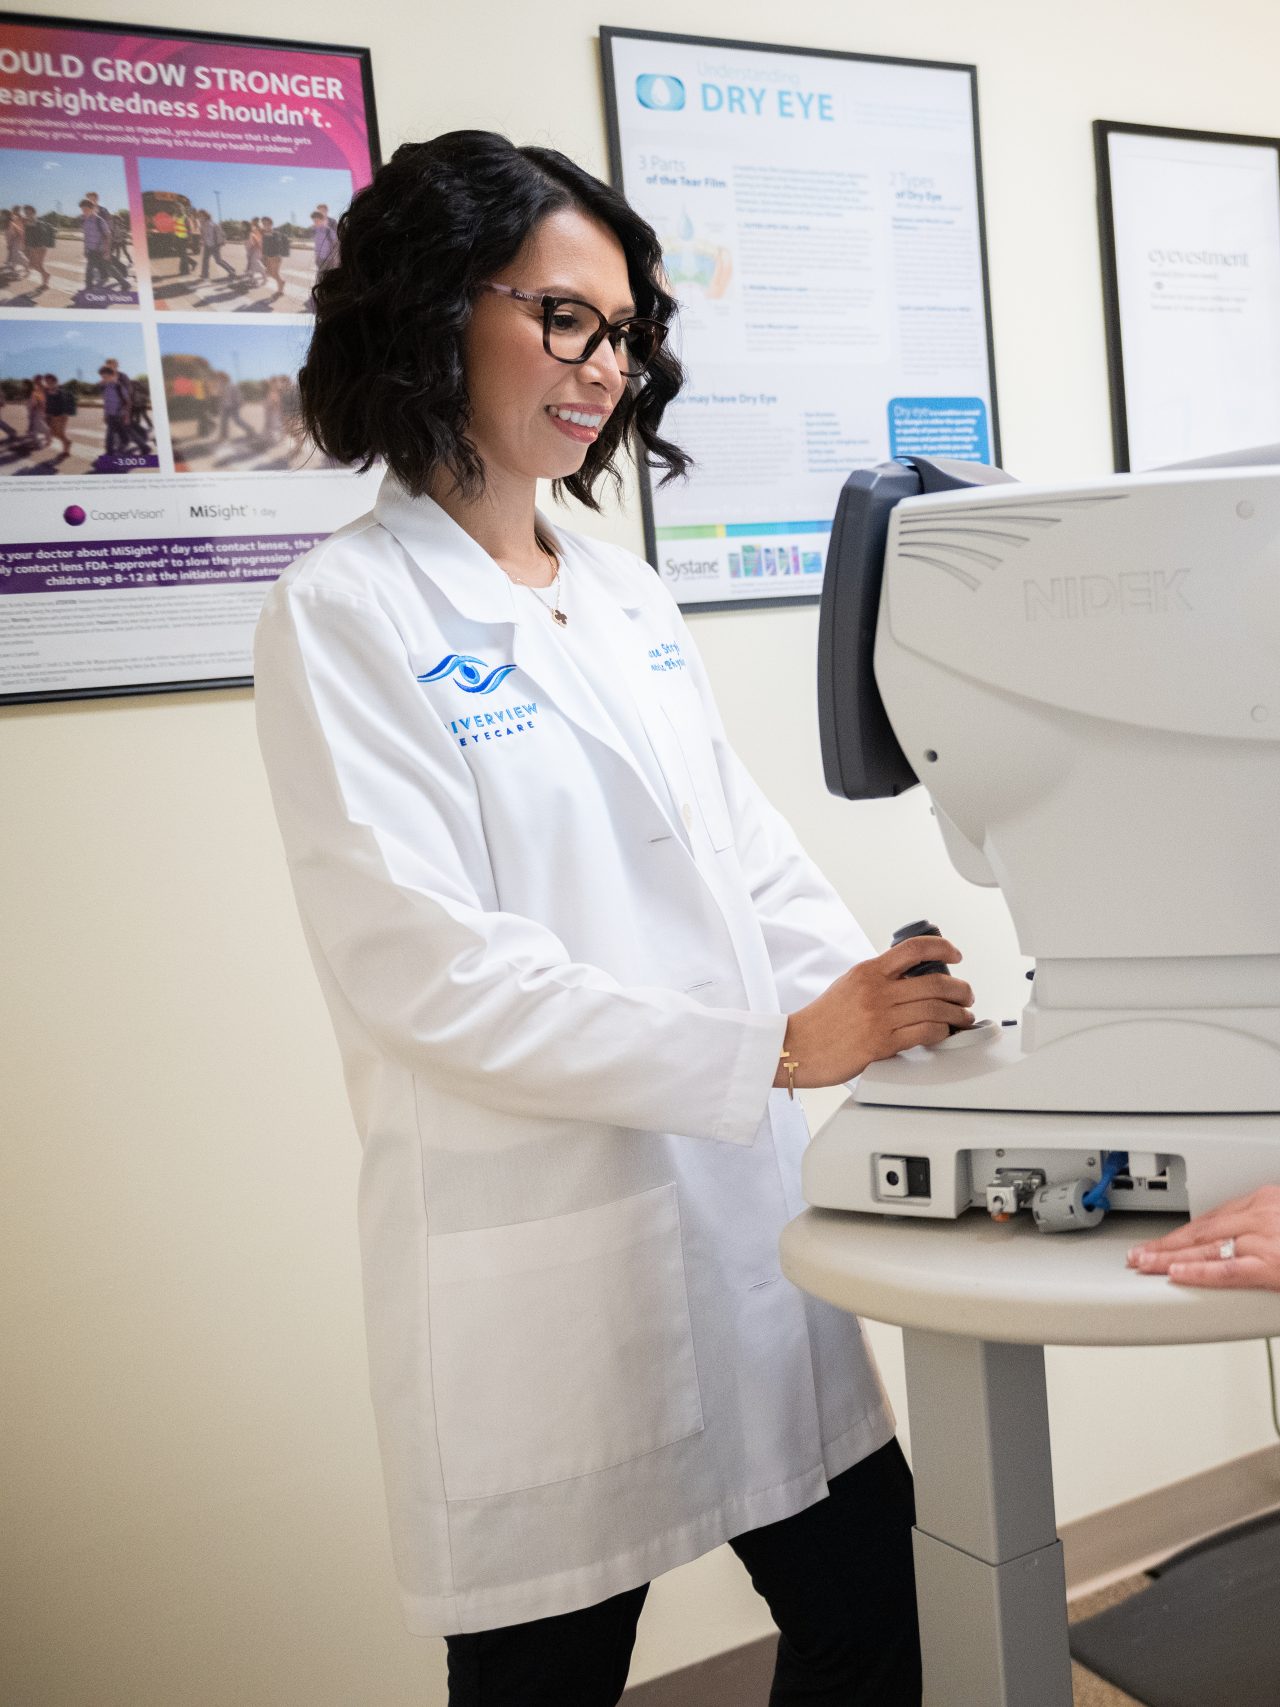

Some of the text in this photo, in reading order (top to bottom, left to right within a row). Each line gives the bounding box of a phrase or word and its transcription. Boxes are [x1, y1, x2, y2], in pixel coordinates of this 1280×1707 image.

[92, 57, 187, 87] GROW
[194, 66, 345, 100] STRONGER
[697, 60, 801, 85] Understanding
[206, 98, 332, 128] shouldn't.
[701, 82, 767, 116] DRY
[777, 90, 835, 122] EYE
[639, 154, 686, 172] 3 Parts
[646, 174, 728, 189] of the Tear Film
[1148, 248, 1250, 268] eyevestment
[7, 552, 33, 562] your
[36, 549, 73, 559] doctor
[76, 548, 108, 558] about
[171, 544, 190, 556] day
[192, 542, 214, 553] soft
[216, 542, 257, 552] contact
[258, 540, 294, 551] lenses,
[294, 540, 311, 550] the
[15, 562, 58, 574] contact
[60, 562, 83, 572] lens
[171, 558, 182, 567] to
[186, 558, 210, 567] slow
[212, 556, 229, 566] the
[232, 553, 292, 567] progression
[46, 575, 90, 586] children
[93, 574, 112, 586] age
[115, 572, 144, 583] 8-12
[146, 572, 157, 581] at
[160, 570, 178, 580] the
[180, 568, 227, 580] initiation
[229, 568, 240, 578] of
[1023, 567, 1193, 621] NIDEK
[459, 721, 535, 746] EYECARE
